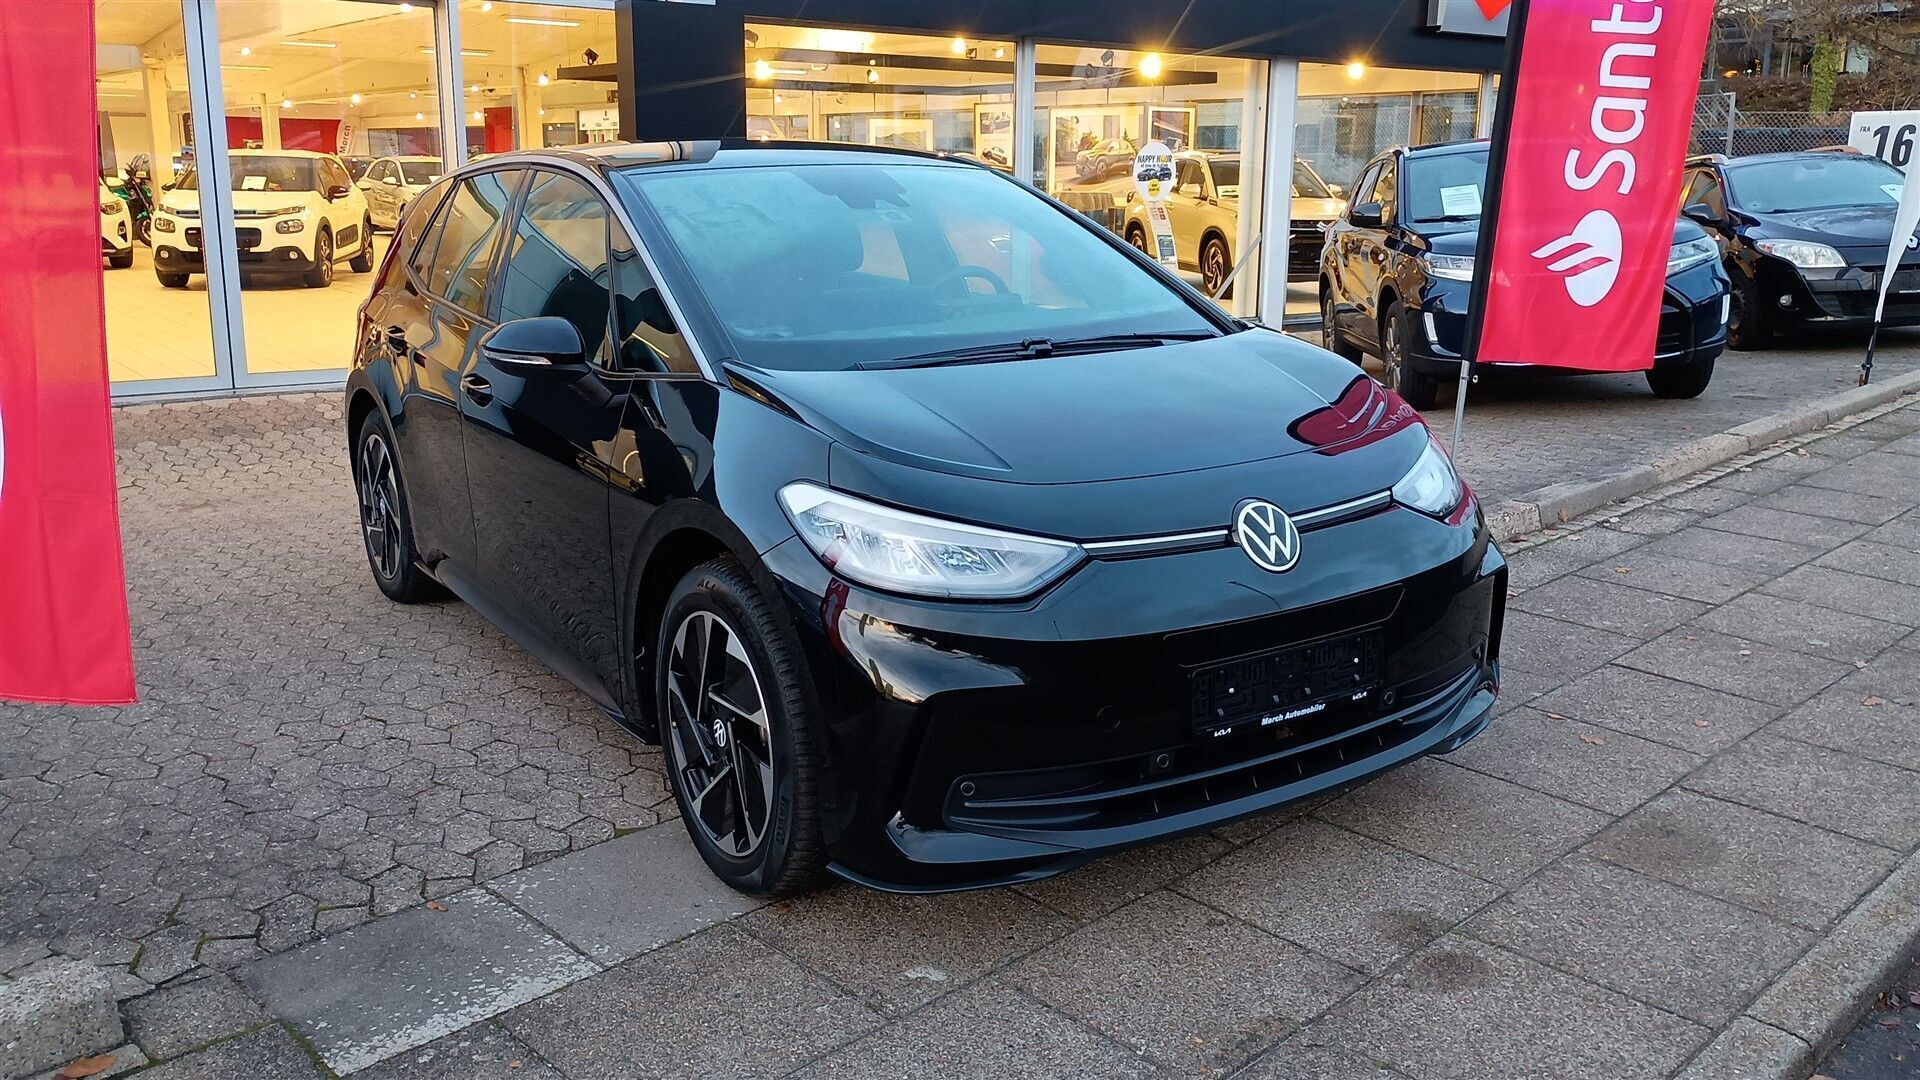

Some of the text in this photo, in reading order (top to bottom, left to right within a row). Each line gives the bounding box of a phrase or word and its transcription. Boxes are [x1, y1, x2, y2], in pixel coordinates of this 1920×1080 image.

[1564, 0, 1663, 195] Sant
[1137, 154, 1156, 163] HAPPY
[1284, 703, 1326, 720] Automobiler
